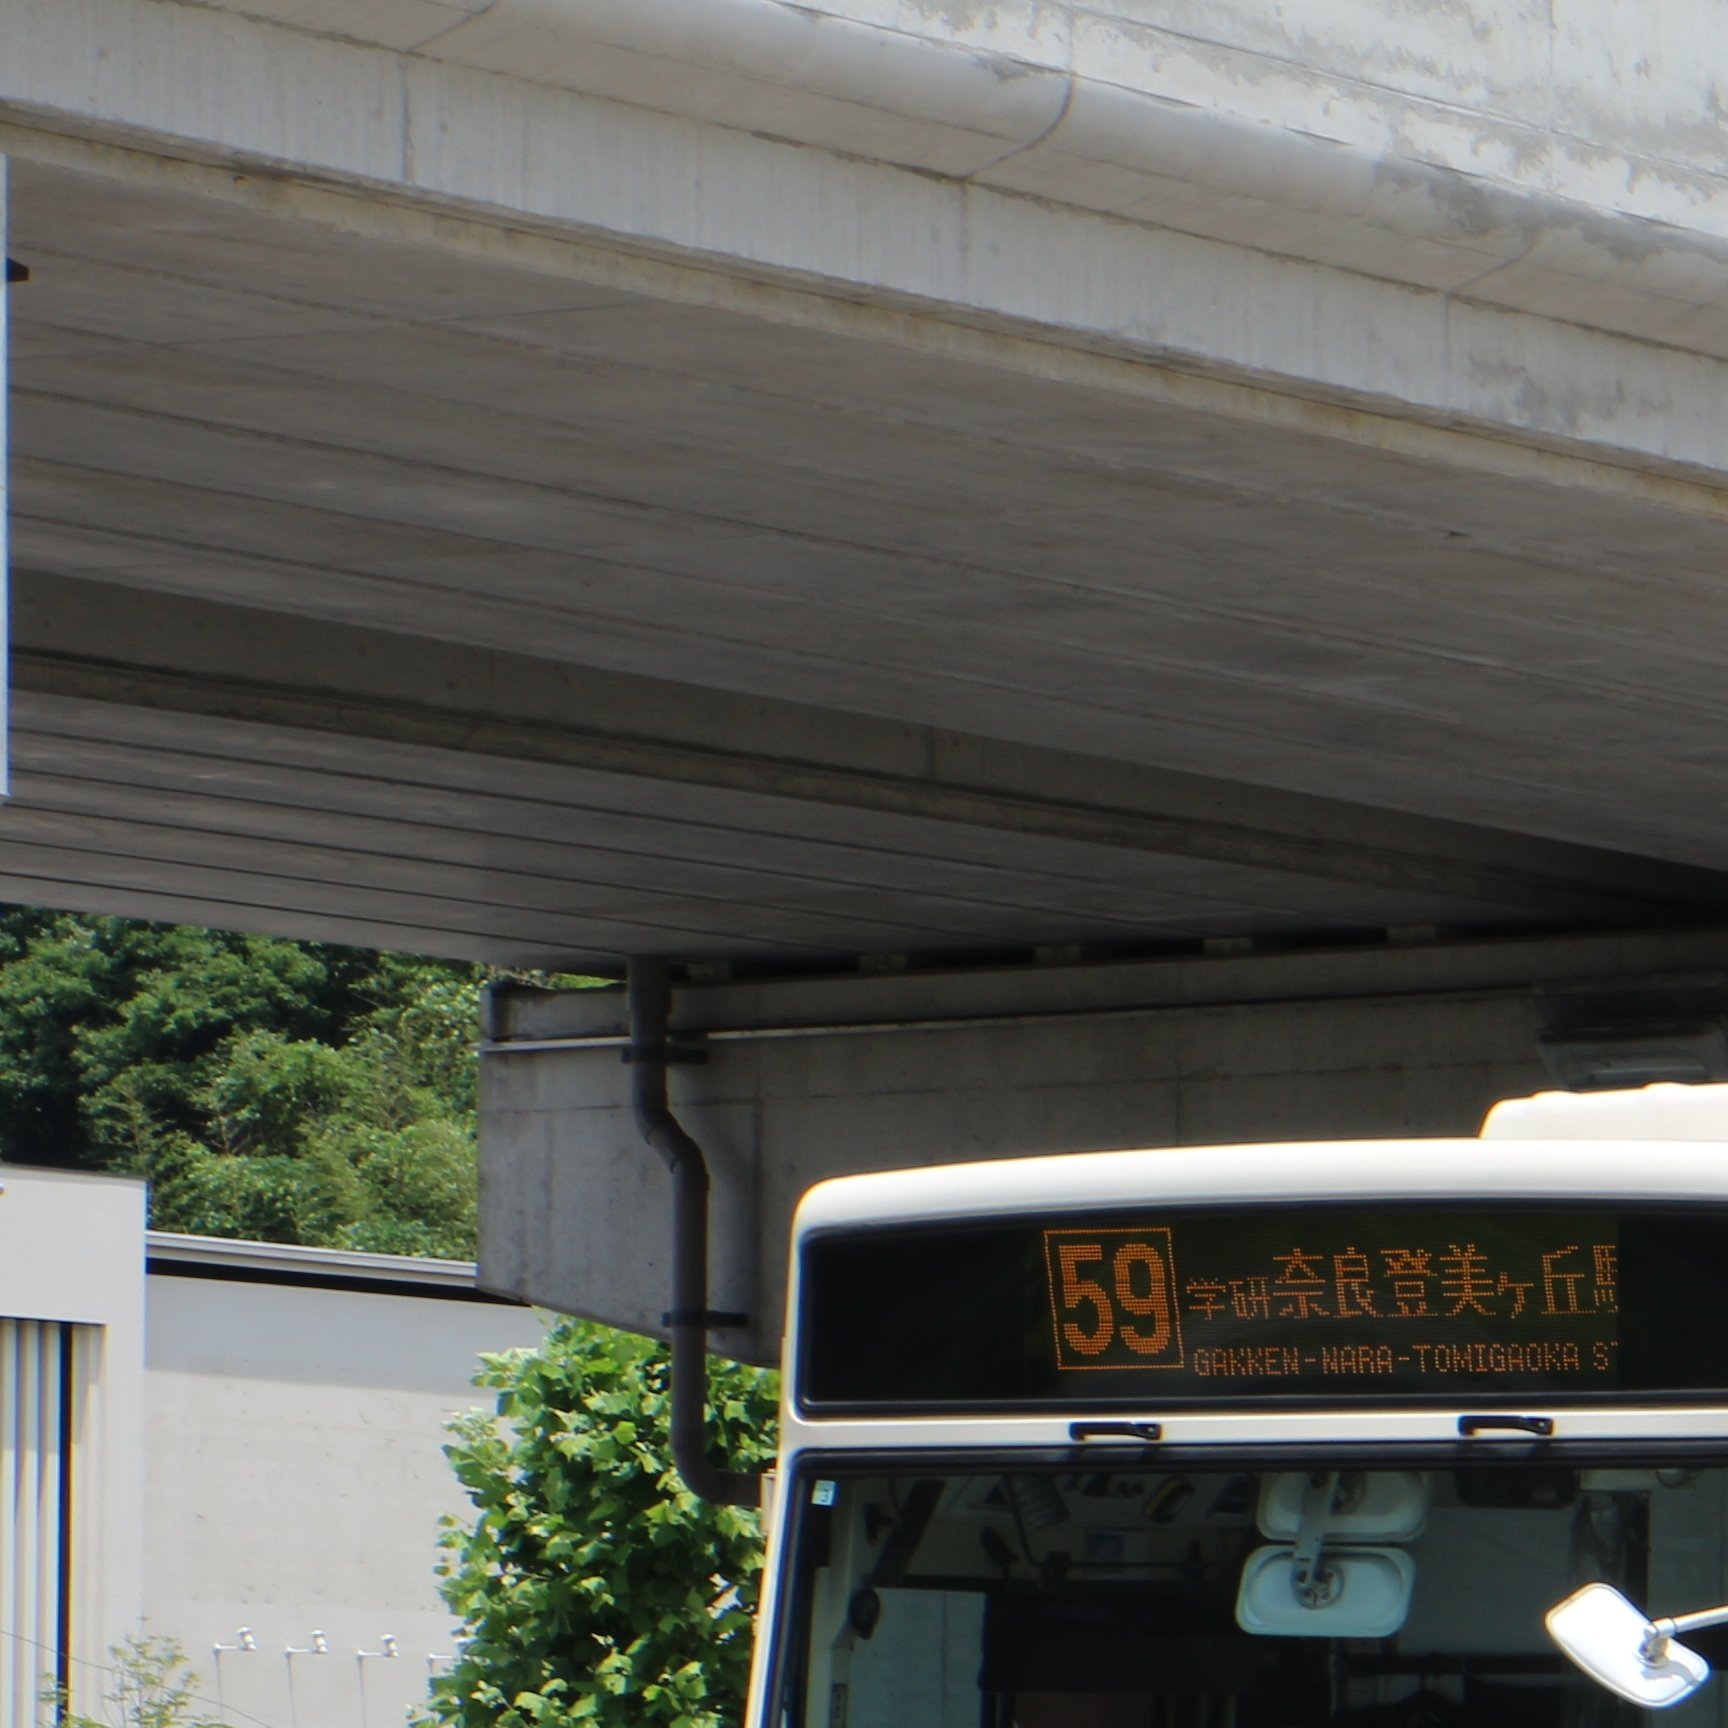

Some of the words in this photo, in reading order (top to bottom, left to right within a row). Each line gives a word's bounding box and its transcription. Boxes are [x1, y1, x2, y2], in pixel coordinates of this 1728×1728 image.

[1058, 1243, 1171, 1355] 59
[1194, 1343, 1580, 1376] GAKKEN-NARA-TOMIGAOKA
[1592, 1341, 1618, 1371] S
